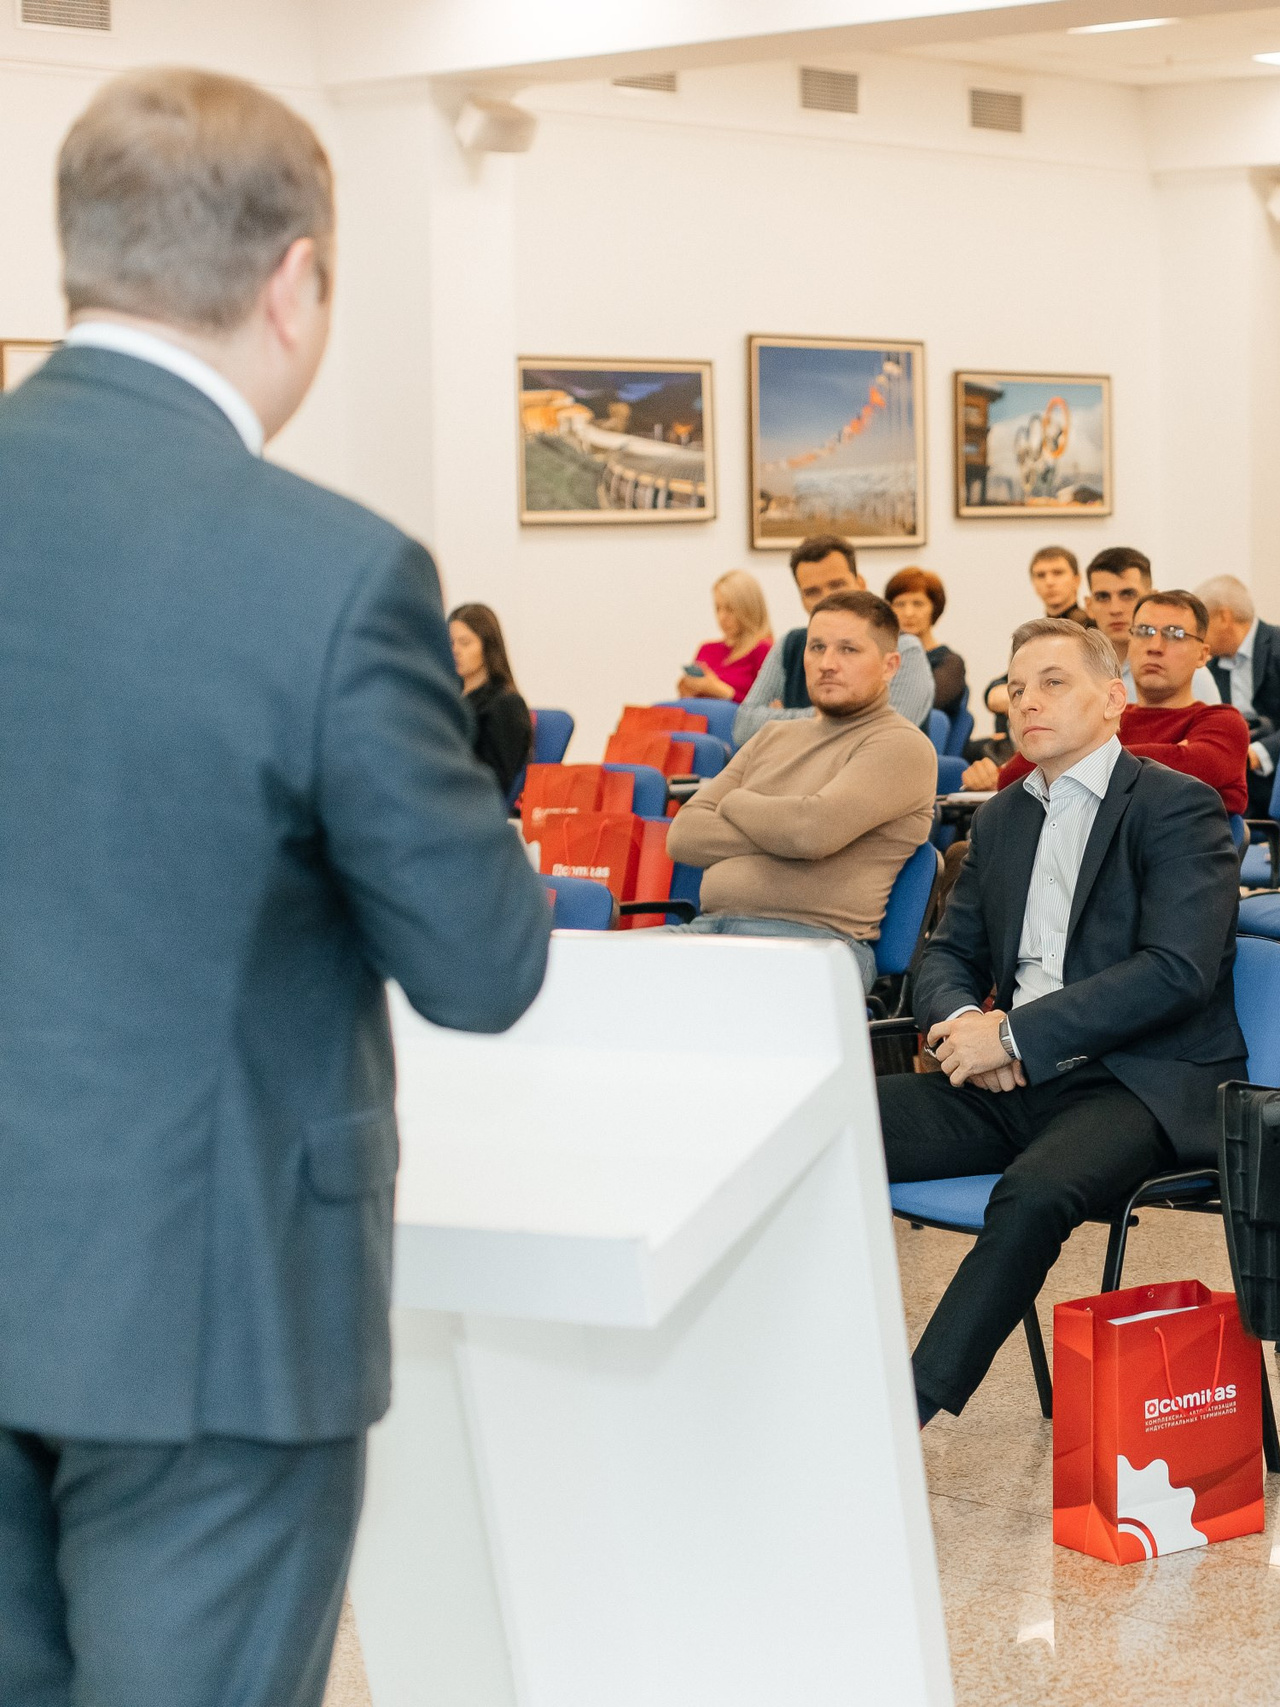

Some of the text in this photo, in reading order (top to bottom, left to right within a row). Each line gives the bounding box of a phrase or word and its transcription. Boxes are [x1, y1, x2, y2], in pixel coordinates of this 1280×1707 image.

[1159, 1384, 1237, 1414] comitas
[1145, 1401, 1237, 1426] КОМПЛЕКСНА АВТОАТИЗАЦИЯ
[1145, 1407, 1237, 1433] ИНДУСТРИАЛЬНЫХ ТЕРМИНАЛОВ
